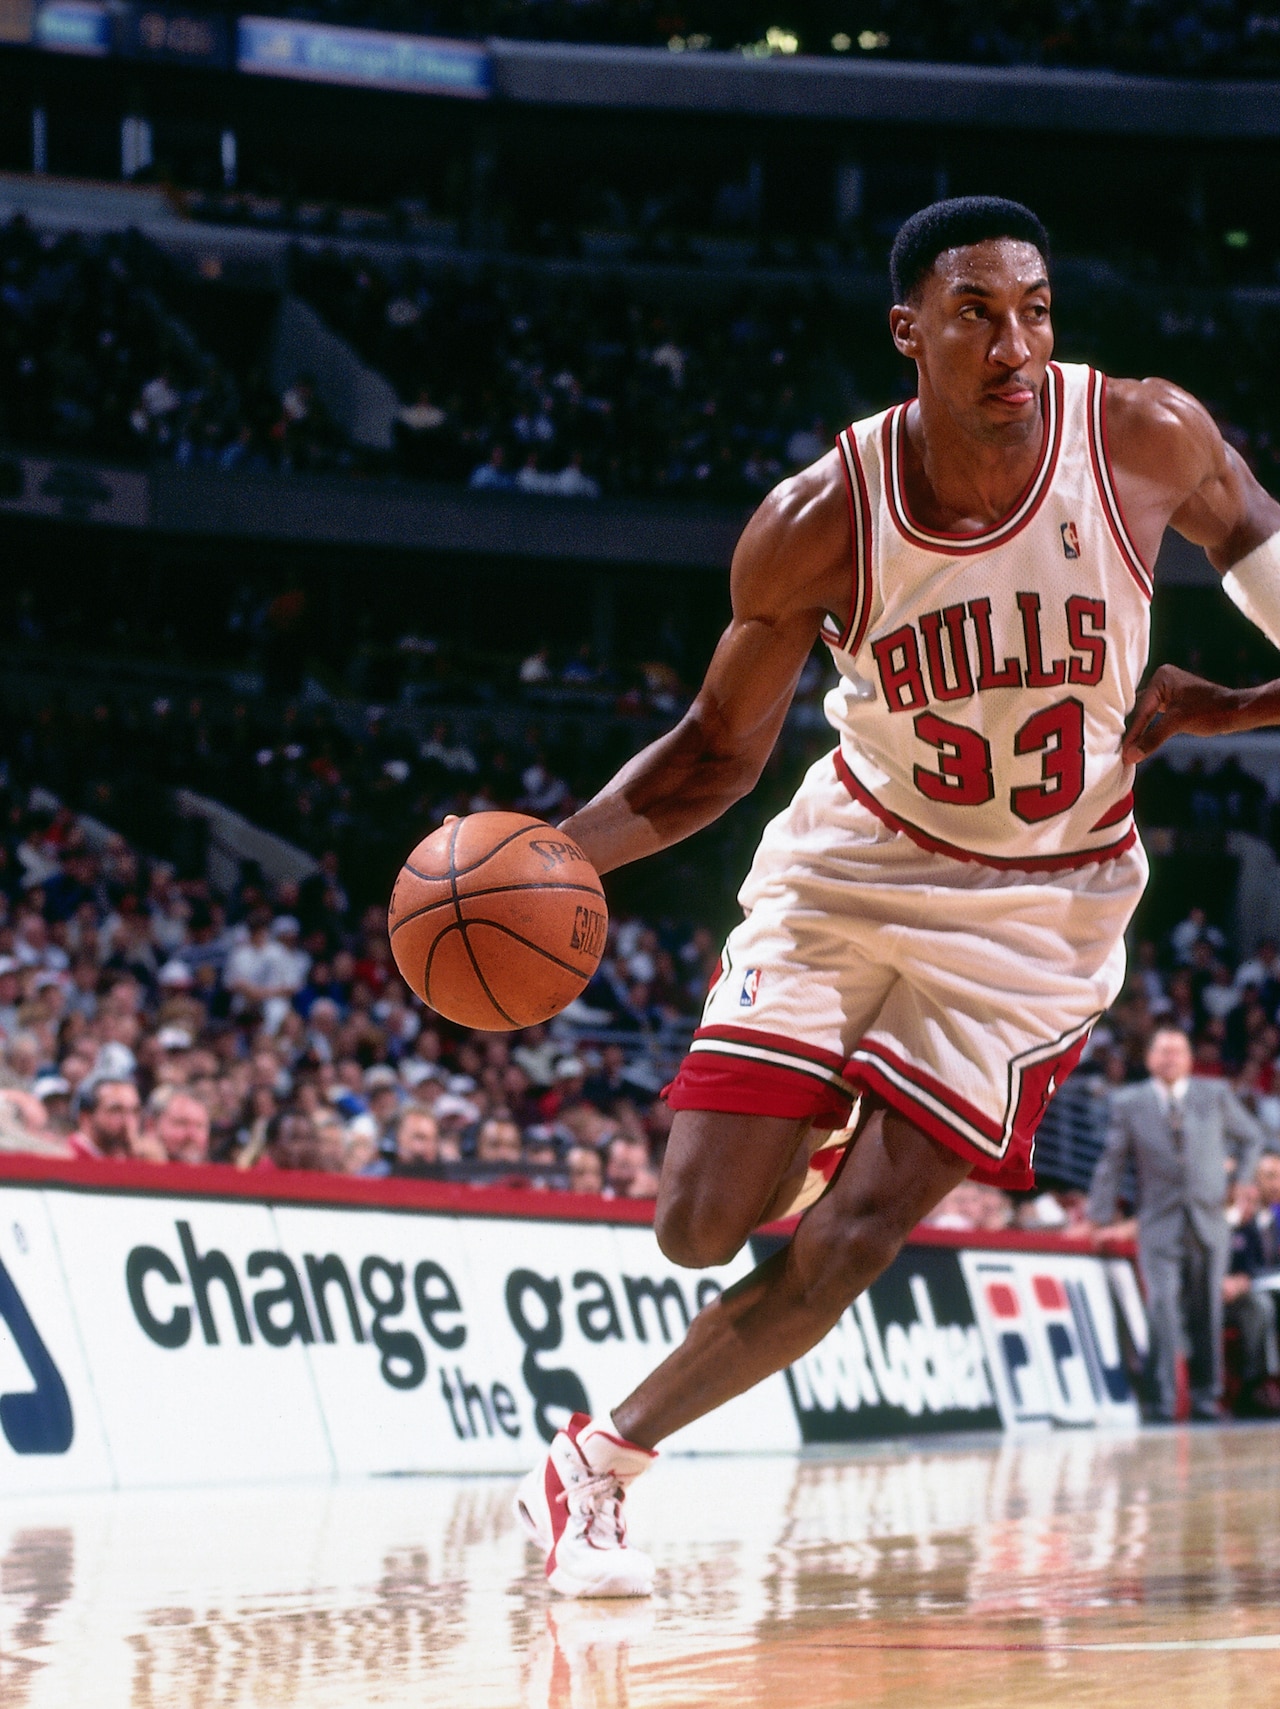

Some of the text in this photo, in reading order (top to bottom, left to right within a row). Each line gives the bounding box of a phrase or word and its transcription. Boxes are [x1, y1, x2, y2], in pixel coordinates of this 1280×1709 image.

[871, 592, 1106, 713] BULLS
[913, 695, 1085, 825] 33
[126, 1220, 467, 1389] change
[439, 1367, 520, 1440] the
